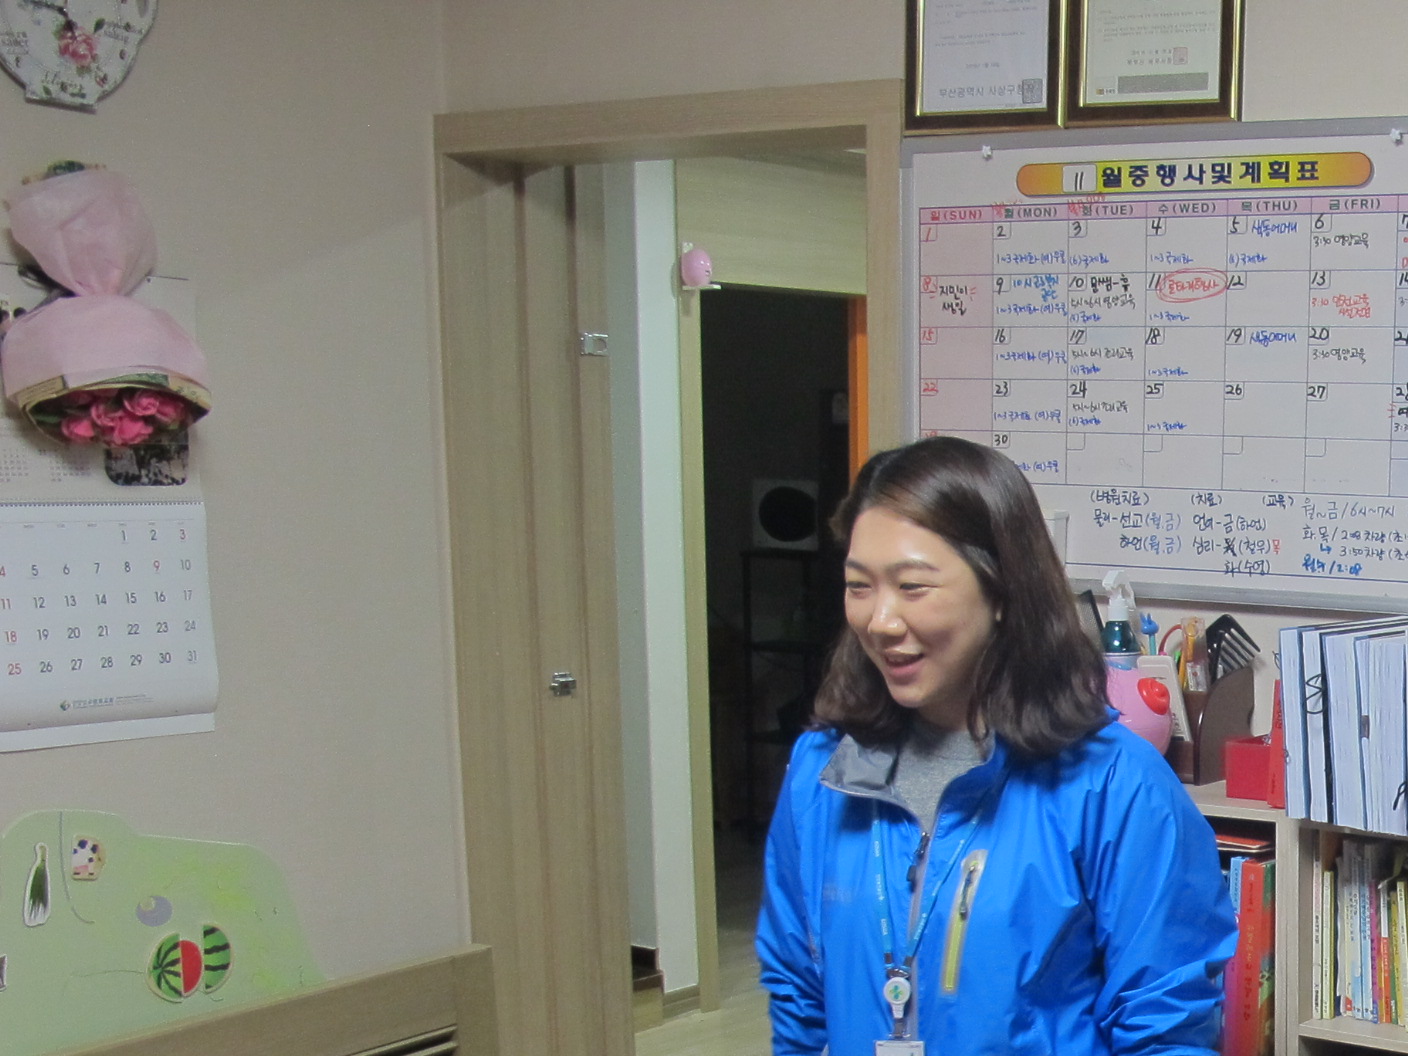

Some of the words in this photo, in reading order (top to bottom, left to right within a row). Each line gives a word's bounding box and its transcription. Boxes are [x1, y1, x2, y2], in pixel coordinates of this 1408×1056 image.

[1101, 160, 1319, 188] 월중행사및계획표
[930, 211, 982, 221] 일(SUN)
[1082, 204, 1134, 216] 화(TUE)
[1159, 203, 1216, 214] 수(WED)
[1241, 201, 1298, 212] 목(THU)
[1329, 200, 1380, 211] 금(FRI)
[926, 226, 932, 238] 1
[996, 226, 1007, 237] 2
[1072, 222, 1082, 236] 3
[1151, 218, 1162, 234] 4
[1230, 217, 1240, 234] 5
[1314, 213, 1324, 230] 6
[996, 278, 1004, 295] 9
[1068, 278, 1086, 288] 10
[1312, 272, 1326, 286] 13
[921, 329, 934, 342] 15
[996, 329, 1006, 343] 16
[1070, 330, 1084, 344] 17
[1145, 328, 1162, 345] 18
[1226, 329, 1242, 344] 19
[1309, 327, 1330, 340] 20
[996, 381, 1009, 395] 23
[1070, 380, 1087, 398] 24
[1146, 384, 1164, 396] 25
[1226, 384, 1242, 396] 26
[1308, 384, 1326, 398] 27
[994, 434, 1008, 446] 30
[1191, 492, 1222, 507] (치료)
[1262, 494, 1294, 509] (교육)
[121, 530, 127, 541] 1
[150, 529, 157, 541] 2
[180, 529, 186, 540] 3
[31, 565, 38, 576] 5
[63, 564, 70, 575] 6
[94, 562, 100, 574] 7
[124, 561, 131, 573] 8
[153, 560, 160, 572] 9
[180, 559, 191, 570] 10
[1, 598, 11, 610] 11
[33, 596, 45, 609] 12
[64, 595, 76, 607] 13
[96, 594, 107, 605] 14
[126, 592, 137, 604] 15
[154, 591, 166, 602] 16
[183, 589, 193, 601] 17
[5, 630, 17, 643] 18
[37, 629, 49, 641] 19
[67, 627, 81, 639] 20
[98, 625, 109, 637] 21
[127, 624, 140, 635] 22
[156, 622, 169, 633] 23
[184, 620, 196, 632] 24
[8, 663, 22, 675] 25
[40, 661, 53, 673] 26
[70, 659, 83, 671] 27
[100, 657, 114, 668] 28
[130, 654, 143, 666] 29
[158, 652, 172, 664] 30
[188, 650, 198, 662] 31
